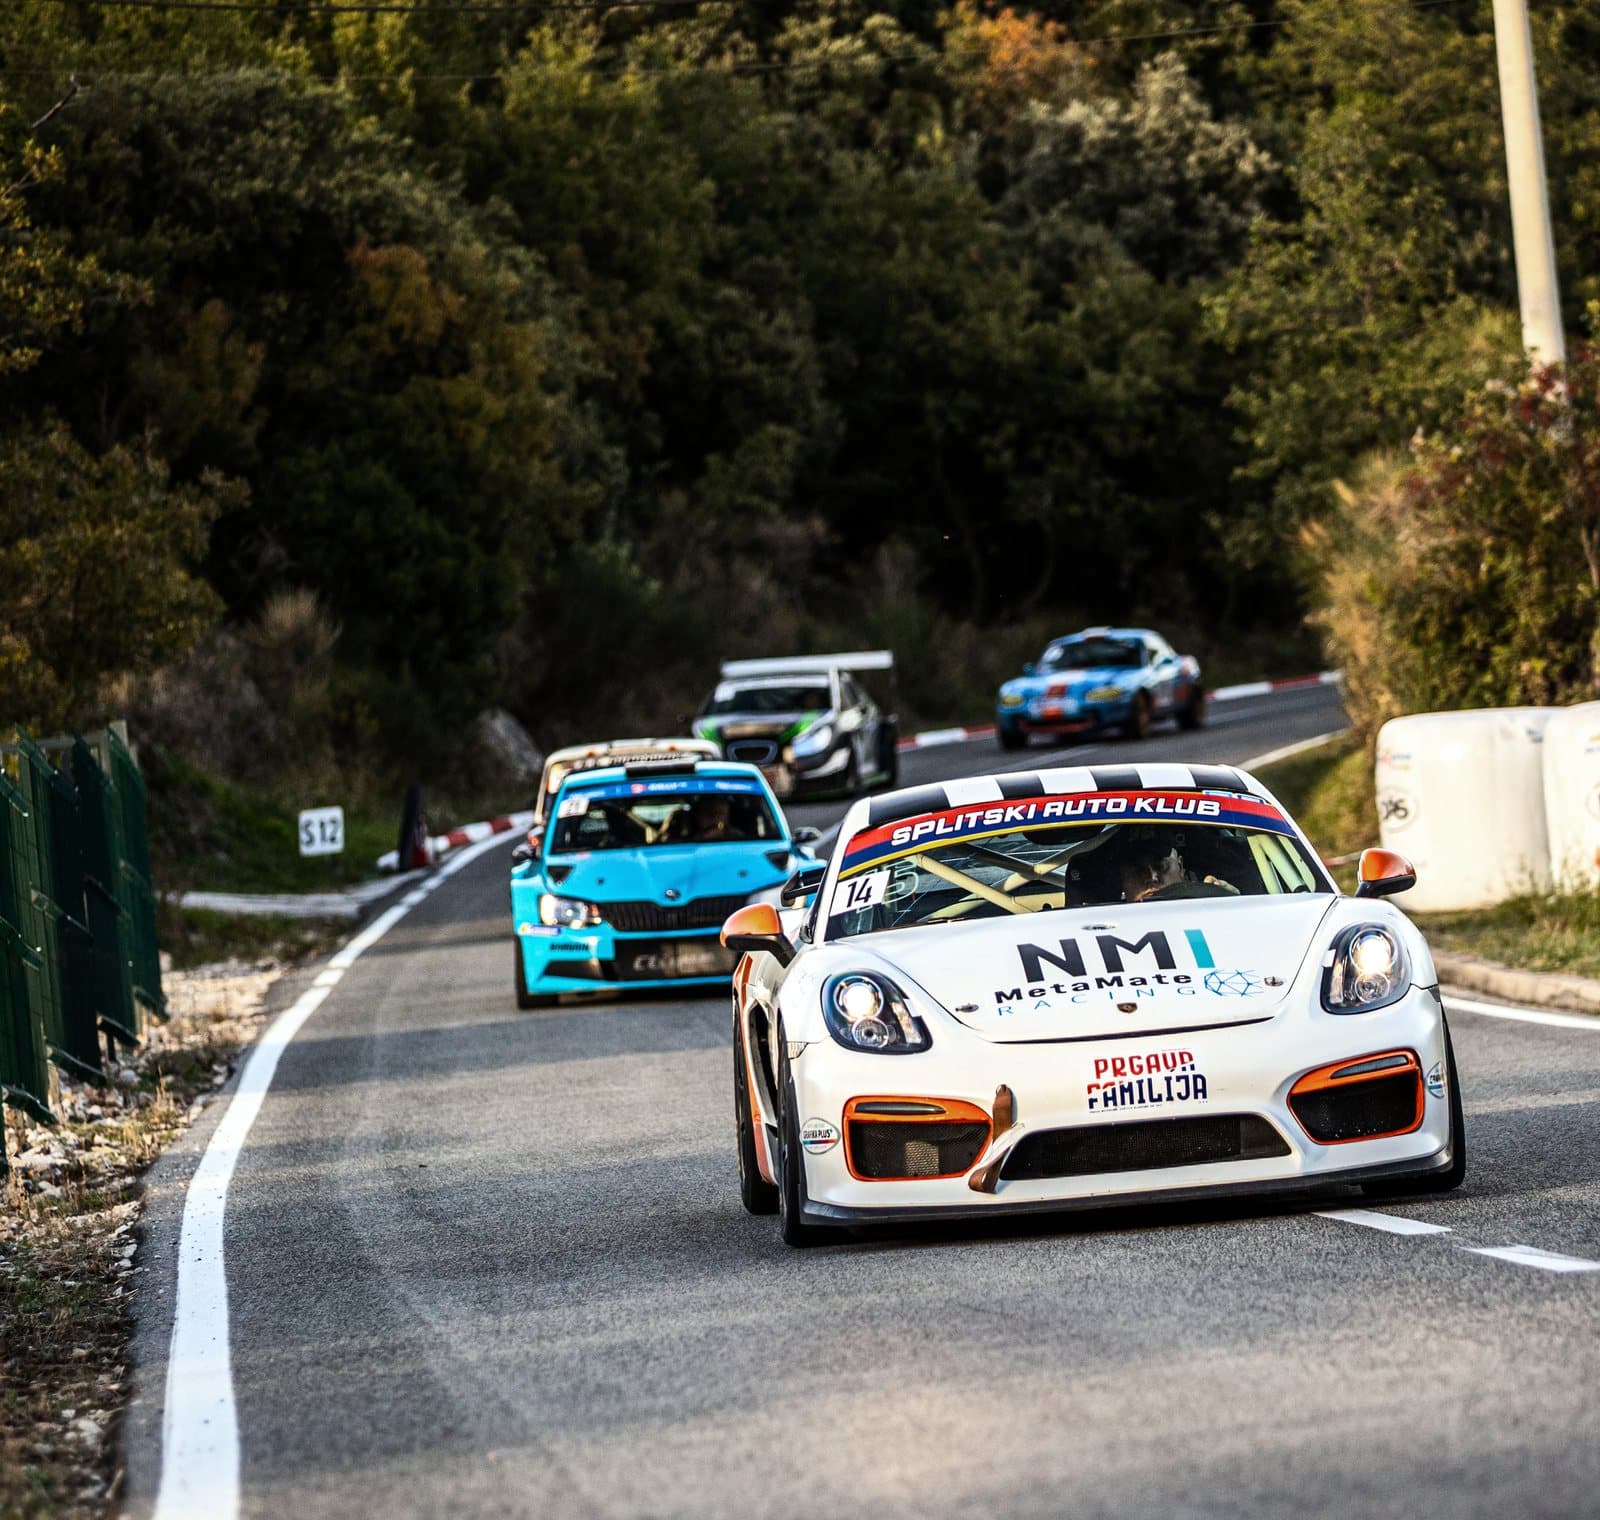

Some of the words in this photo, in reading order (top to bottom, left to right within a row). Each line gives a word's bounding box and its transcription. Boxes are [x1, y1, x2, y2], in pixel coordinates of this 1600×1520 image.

[302, 817, 339, 846] S12
[891, 803, 1037, 846] SPLITSKI
[1043, 798, 1128, 818] AUTO
[1134, 798, 1221, 816] KLUB
[846, 877, 873, 909] 14
[1016, 929, 1216, 984] NMI
[994, 973, 1193, 1004] MetaMate
[997, 986, 1197, 1017] RACING
[1087, 1073, 1208, 1109] FAMILIJA
[818, 1129, 831, 1139] PLUS
